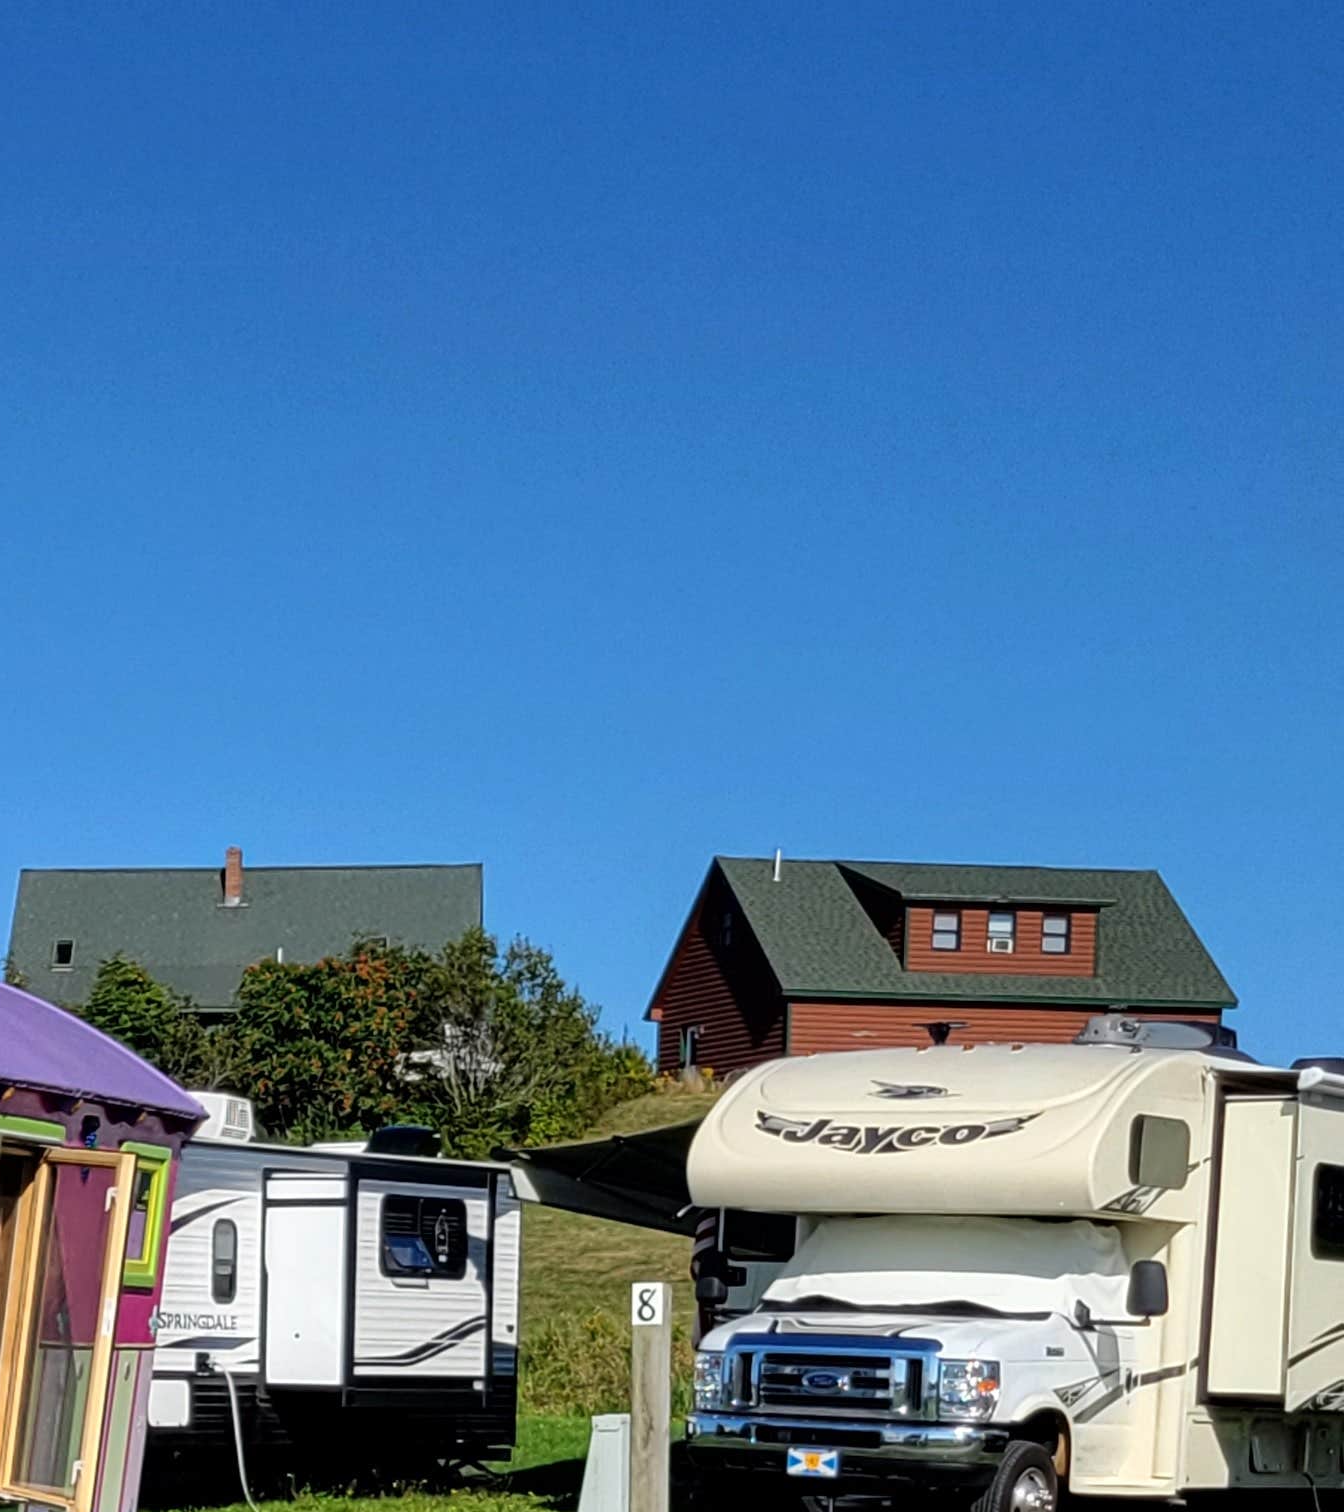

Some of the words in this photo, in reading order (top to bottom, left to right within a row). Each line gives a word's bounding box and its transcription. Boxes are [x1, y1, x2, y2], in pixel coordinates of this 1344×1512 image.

[782, 1119, 987, 1154] Jayco
[638, 1288, 656, 1321] 8
[158, 1312, 238, 1331] SPRINGDALE
